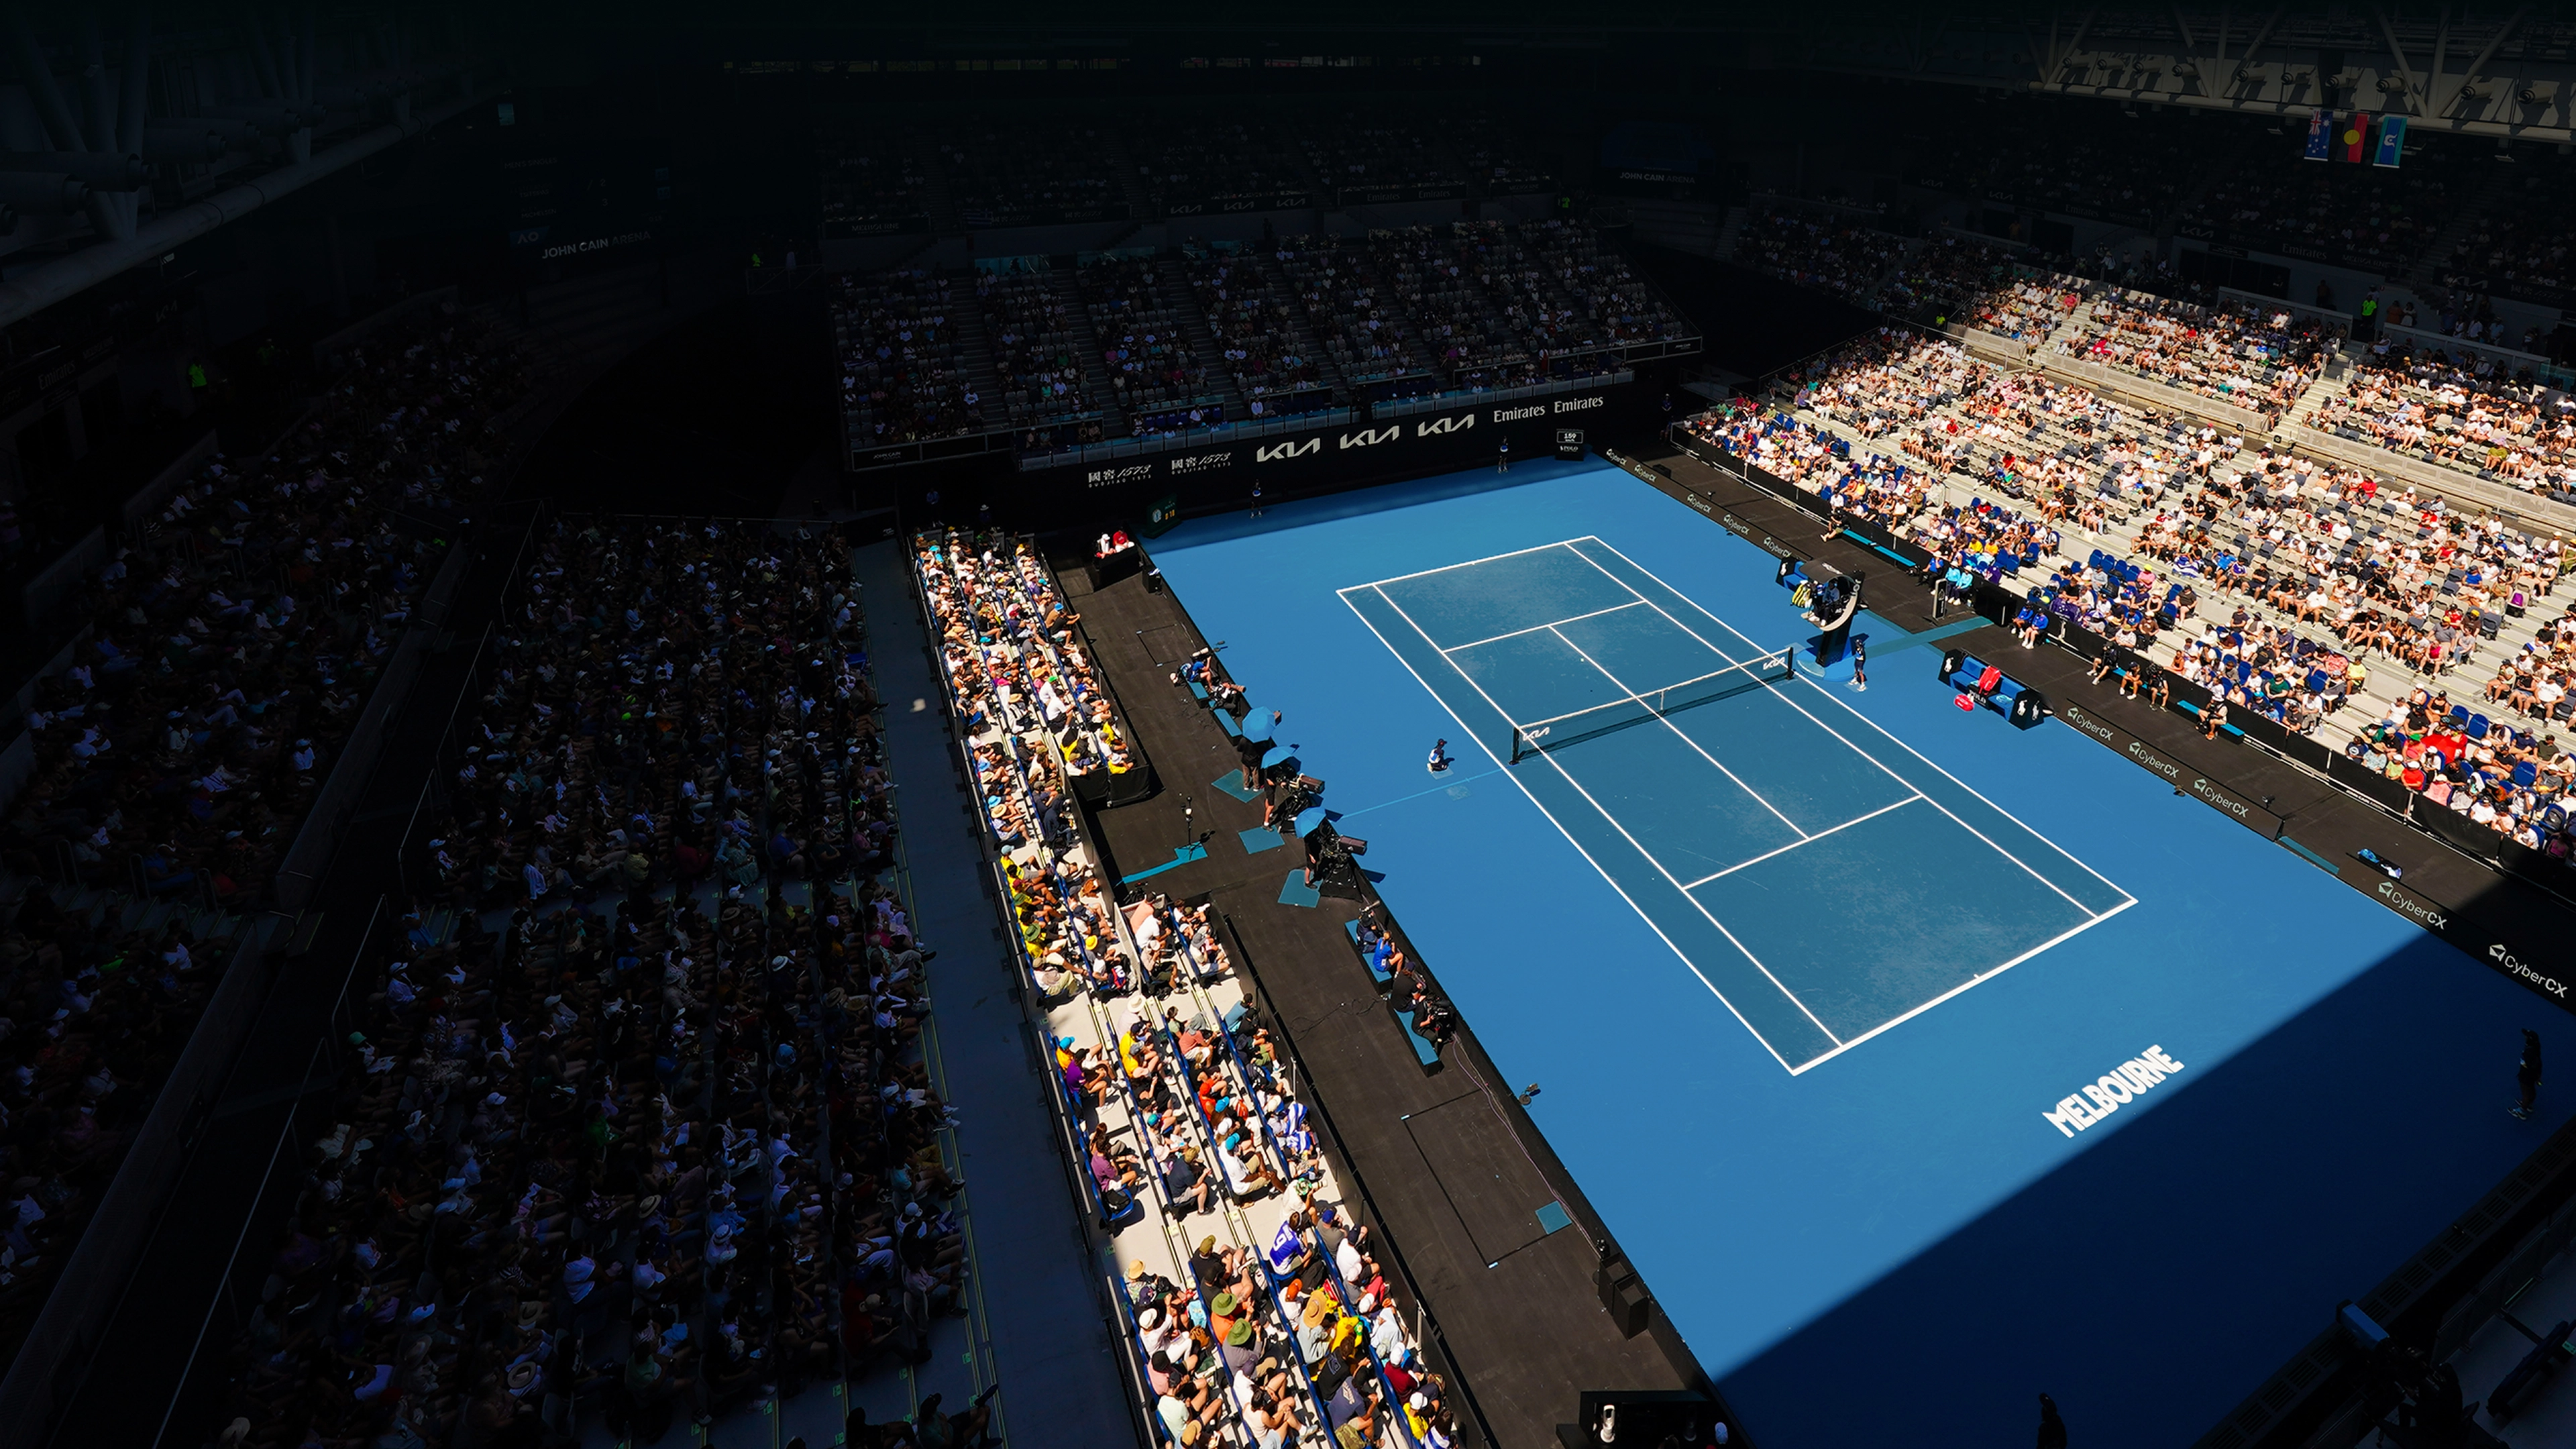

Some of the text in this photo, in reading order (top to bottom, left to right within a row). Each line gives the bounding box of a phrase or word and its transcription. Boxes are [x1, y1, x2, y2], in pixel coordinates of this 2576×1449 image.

[1619, 172, 1695, 184] JOHN CAIN ARENA
[1367, 192, 1401, 202] Emirates
[1418, 189, 1450, 199] Emirates
[2065, 204, 2100, 218] Emirates
[542, 231, 651, 259] JOHN CAIN ARENA
[2282, 243, 2327, 260] Emirates
[1493, 405, 1546, 423] Emirates
[1554, 396, 1604, 414] Emirates
[1340, 425, 1400, 449] KIA
[1417, 413, 1474, 437] KIA
[1256, 437, 1320, 463] KIA
[2075, 712, 2114, 741] CyberCX
[2138, 748, 2180, 779] CyberCX
[2203, 785, 2249, 818] CyberCX
[2391, 891, 2448, 930] CyberCX
[2504, 955, 2568, 998] CyberCX
[2042, 1044, 2185, 1138] MELBOURNE
